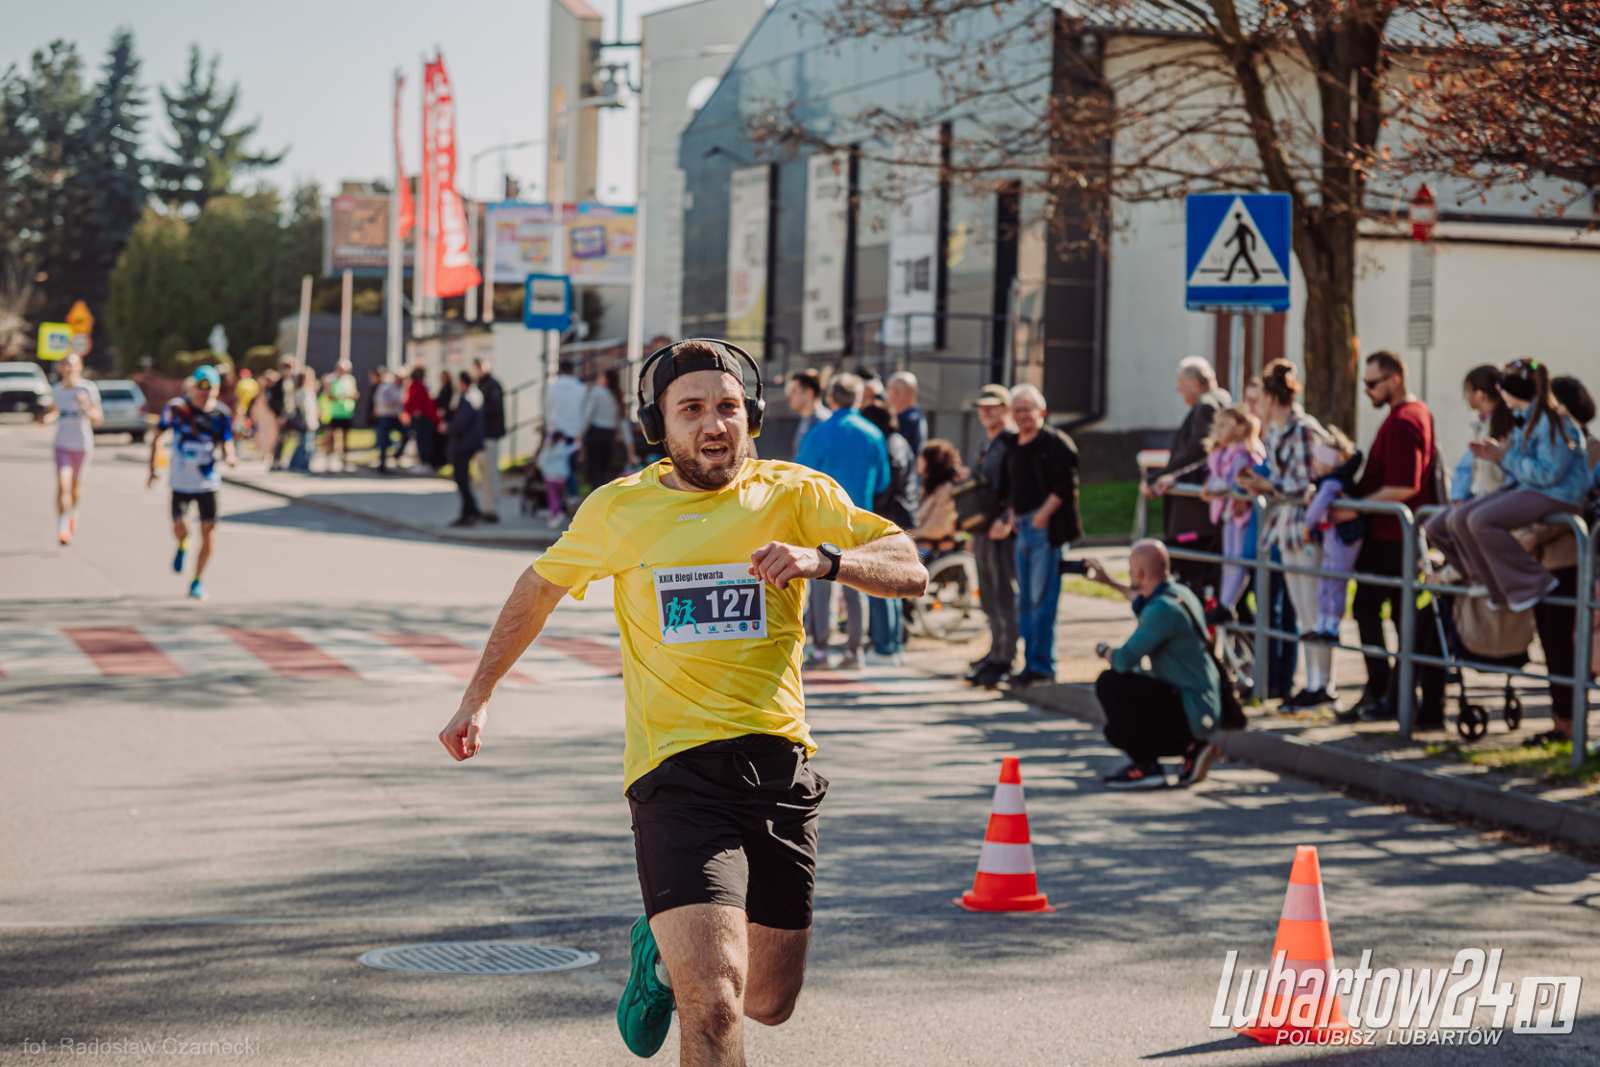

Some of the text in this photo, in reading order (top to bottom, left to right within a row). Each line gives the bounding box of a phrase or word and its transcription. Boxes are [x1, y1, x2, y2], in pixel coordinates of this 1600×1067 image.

[675, 572, 693, 583] Biegi
[694, 570, 724, 581] Lewarta
[705, 588, 755, 619] 127
